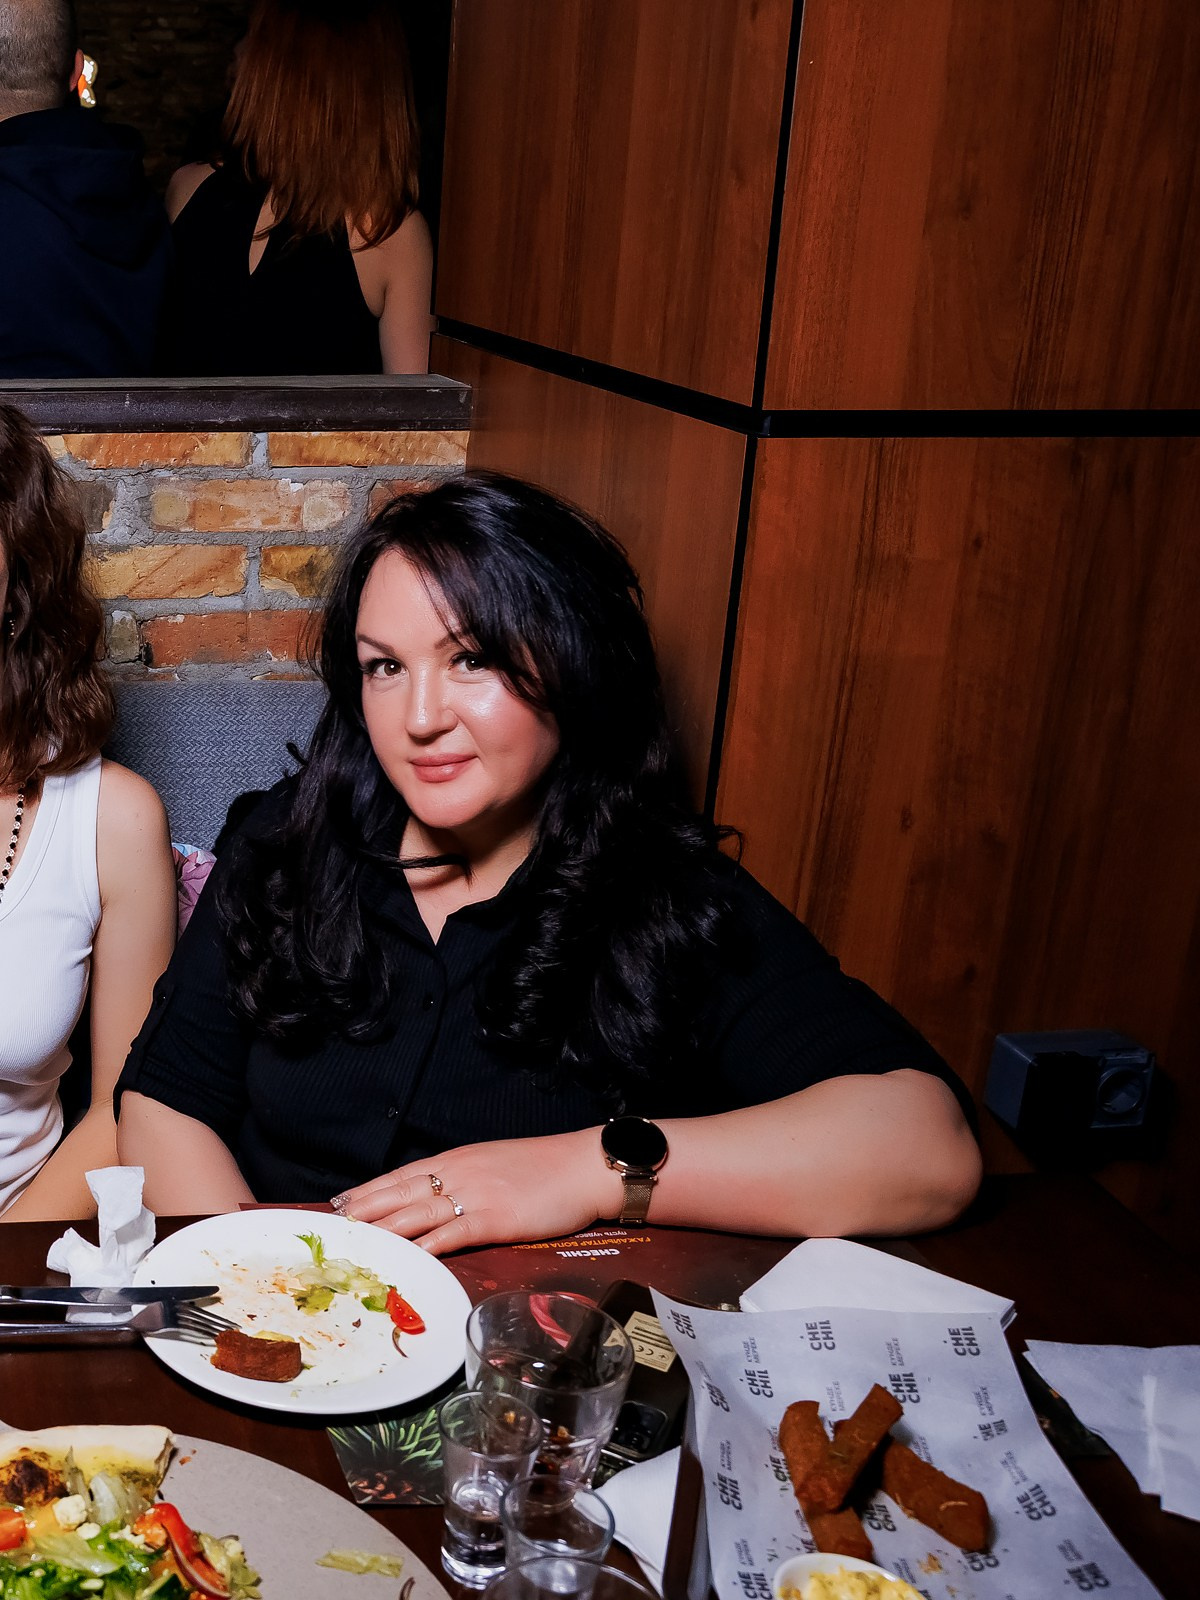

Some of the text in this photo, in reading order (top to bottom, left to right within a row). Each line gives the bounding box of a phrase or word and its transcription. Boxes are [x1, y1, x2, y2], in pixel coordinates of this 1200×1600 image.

[556, 1248, 620, 1258] CHECHIL
[670, 1310, 685, 1334] CHE
[680, 1315, 696, 1339] CHIL
[805, 1322, 822, 1350] CHE
[819, 1320, 835, 1350] CHIL
[948, 1328, 966, 1356] CHE
[962, 1326, 981, 1356] CHIL
[745, 1369, 761, 1395] CHE
[757, 1369, 773, 1398] CHIL
[903, 1372, 920, 1404] CHIL
[717, 1473, 730, 1505] CHE
[728, 1478, 742, 1510] CHIL
[1016, 1492, 1042, 1521] CHE
[737, 1571, 758, 1599] CHE
